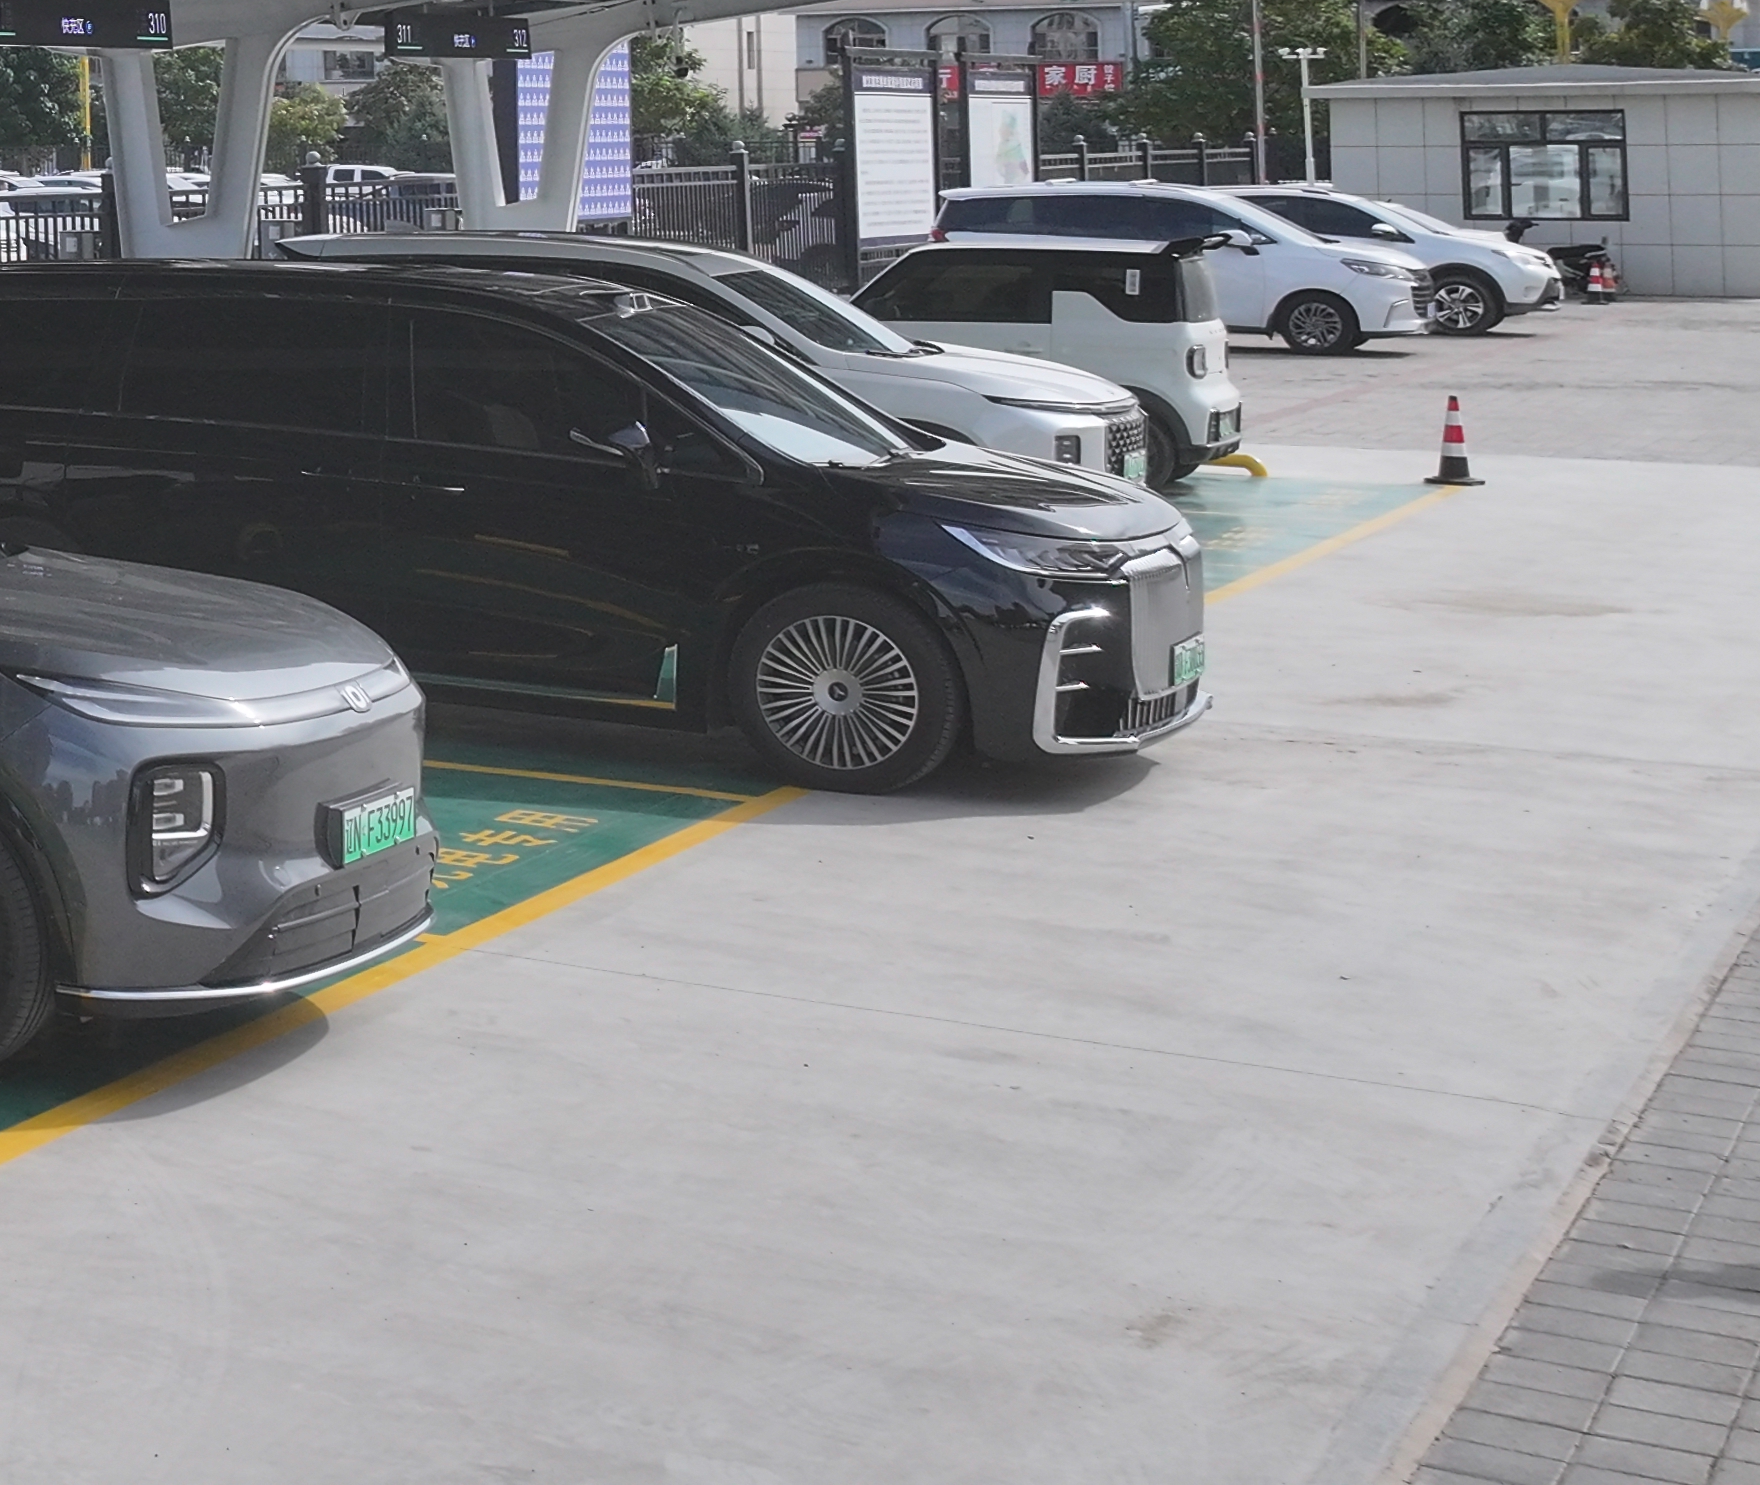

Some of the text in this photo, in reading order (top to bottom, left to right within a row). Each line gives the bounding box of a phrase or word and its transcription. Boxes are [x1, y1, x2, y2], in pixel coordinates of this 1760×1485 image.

[148, 12, 166, 34] 310
[396, 23, 412, 44] 311
[512, 29, 528, 48] 312
